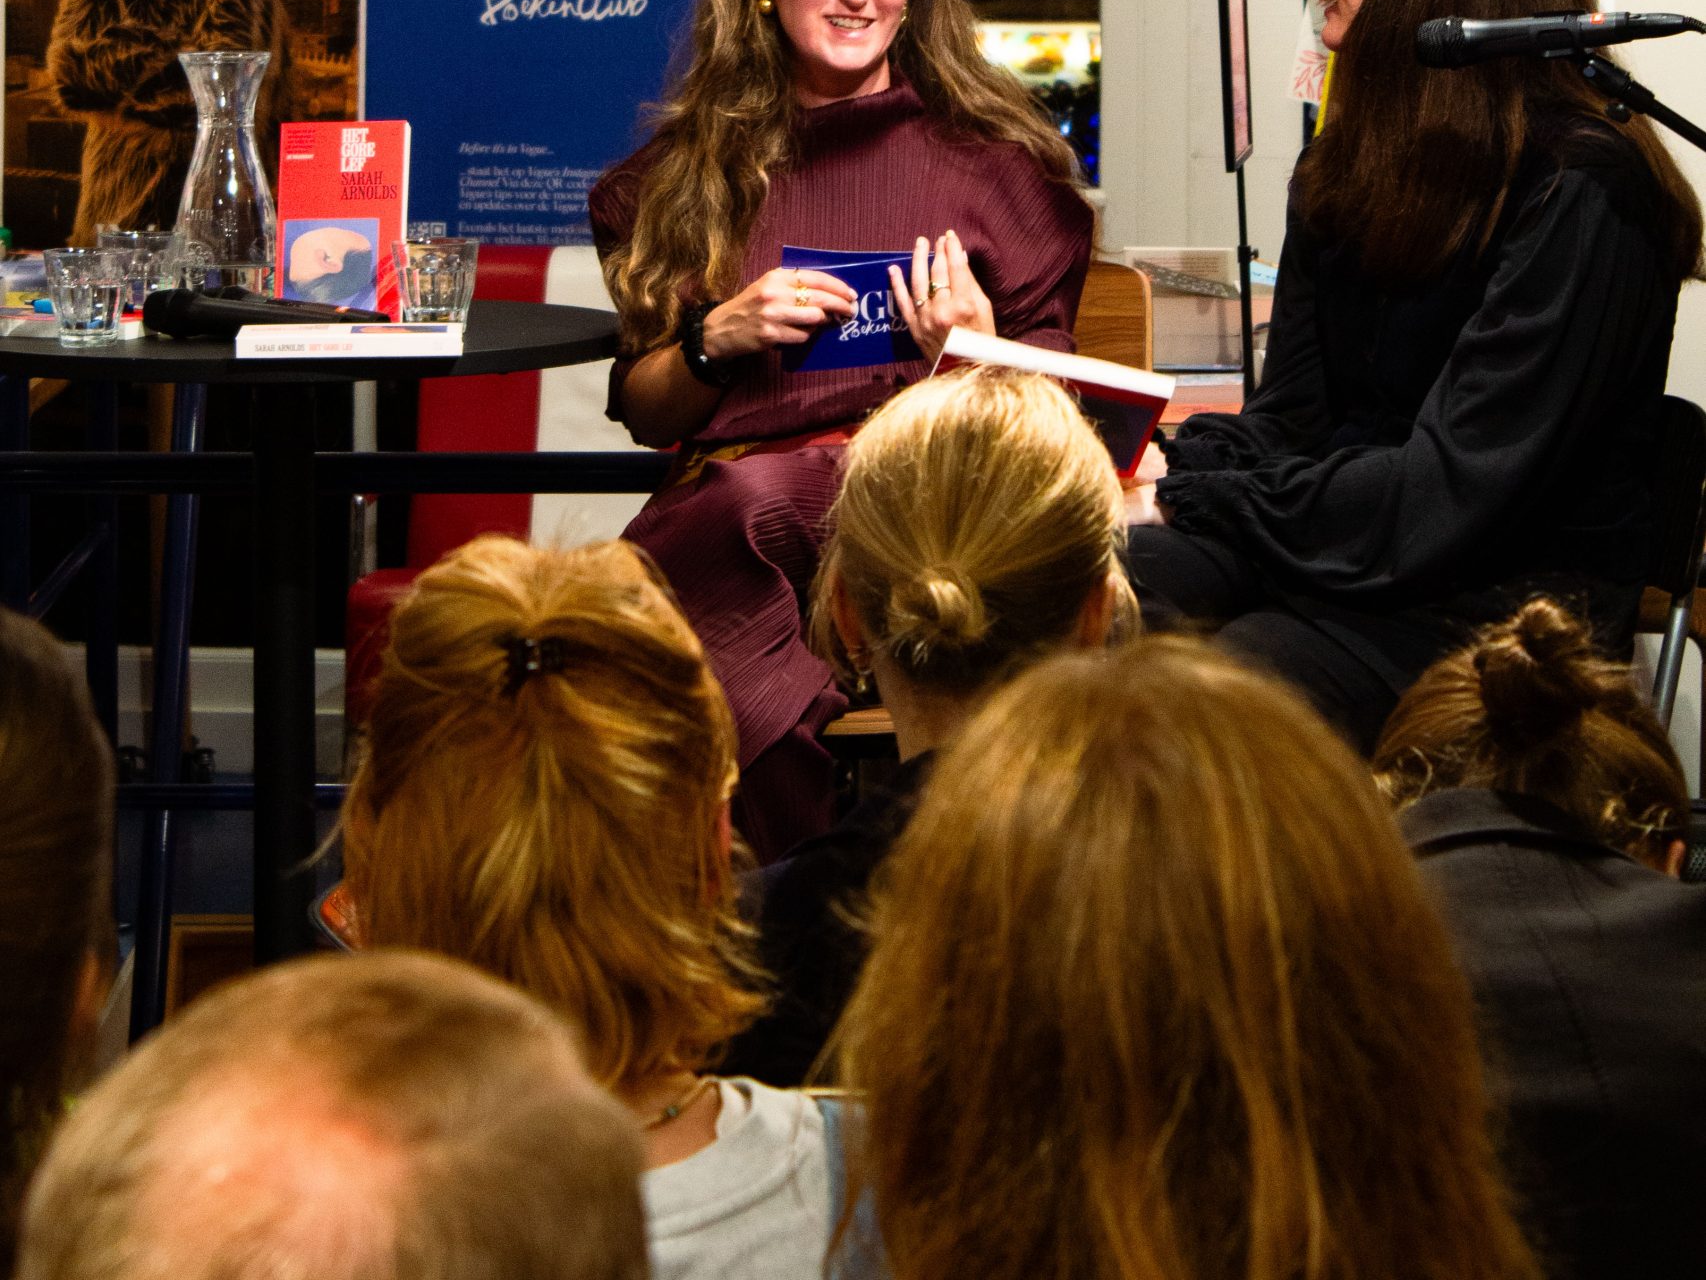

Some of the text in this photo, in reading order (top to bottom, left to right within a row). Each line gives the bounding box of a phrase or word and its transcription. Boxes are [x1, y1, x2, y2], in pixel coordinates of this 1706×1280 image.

[341, 127, 369, 143] HET
[341, 142, 376, 158] GORE
[340, 157, 367, 173] LEF
[341, 171, 383, 186] SARAH
[341, 185, 397, 200] ARNOLDS
